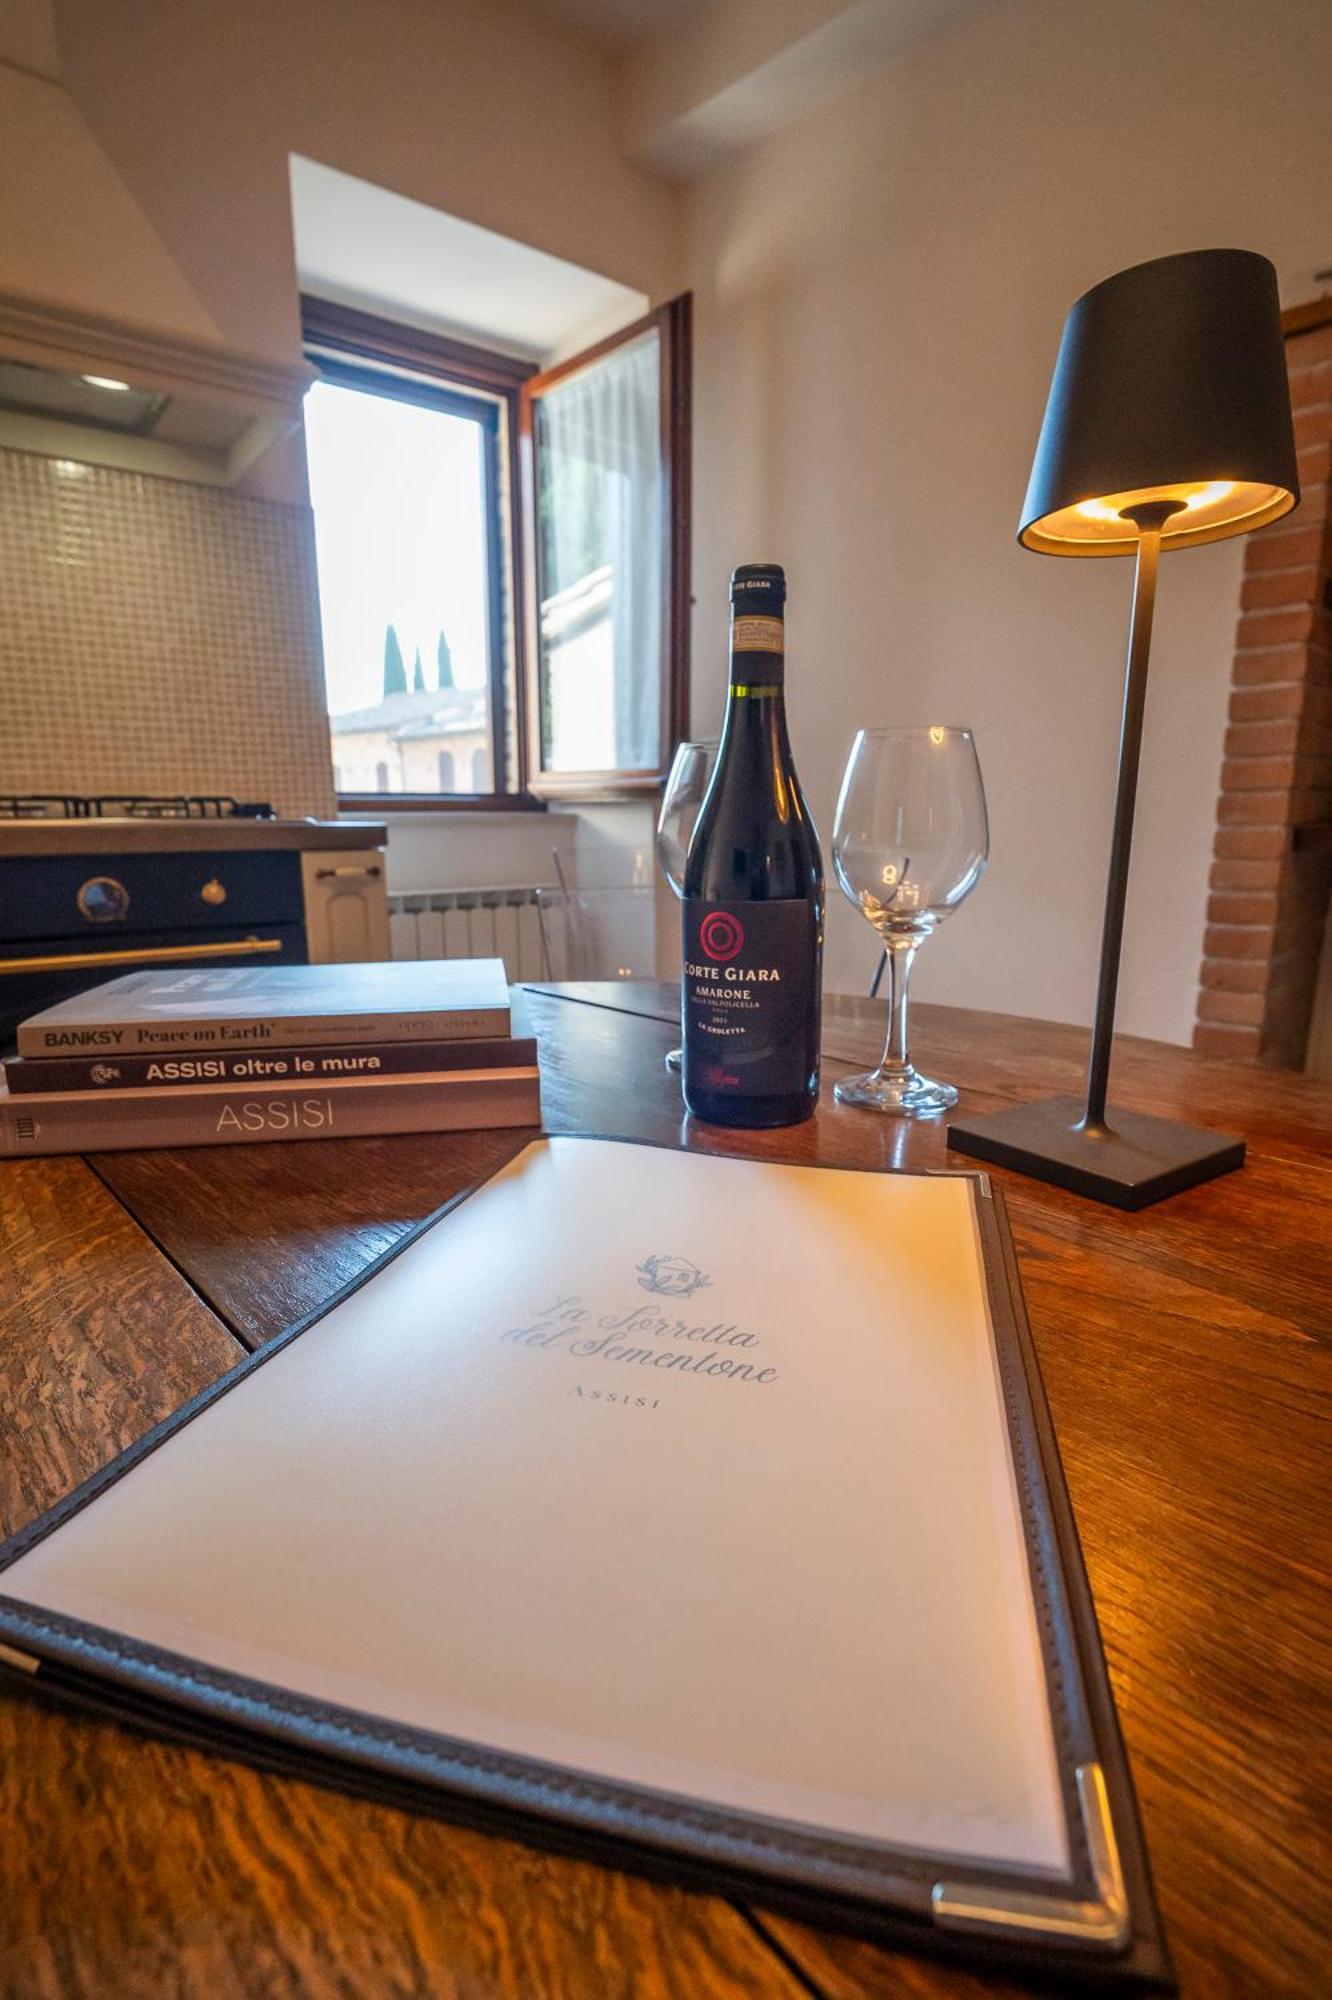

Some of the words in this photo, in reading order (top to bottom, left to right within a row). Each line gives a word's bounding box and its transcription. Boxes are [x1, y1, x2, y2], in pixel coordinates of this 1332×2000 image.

[724, 967, 780, 981] GIARA
[695, 986, 751, 999] AMARONE
[45, 1031, 124, 1047] BANKSY
[137, 1028, 193, 1044] Peace
[197, 1030, 216, 1041] on
[146, 1062, 226, 1080] ASSISI
[233, 1060, 288, 1076] oltre
[295, 1057, 316, 1073] le
[322, 1055, 381, 1071] mura
[217, 1099, 333, 1133] ASSISI
